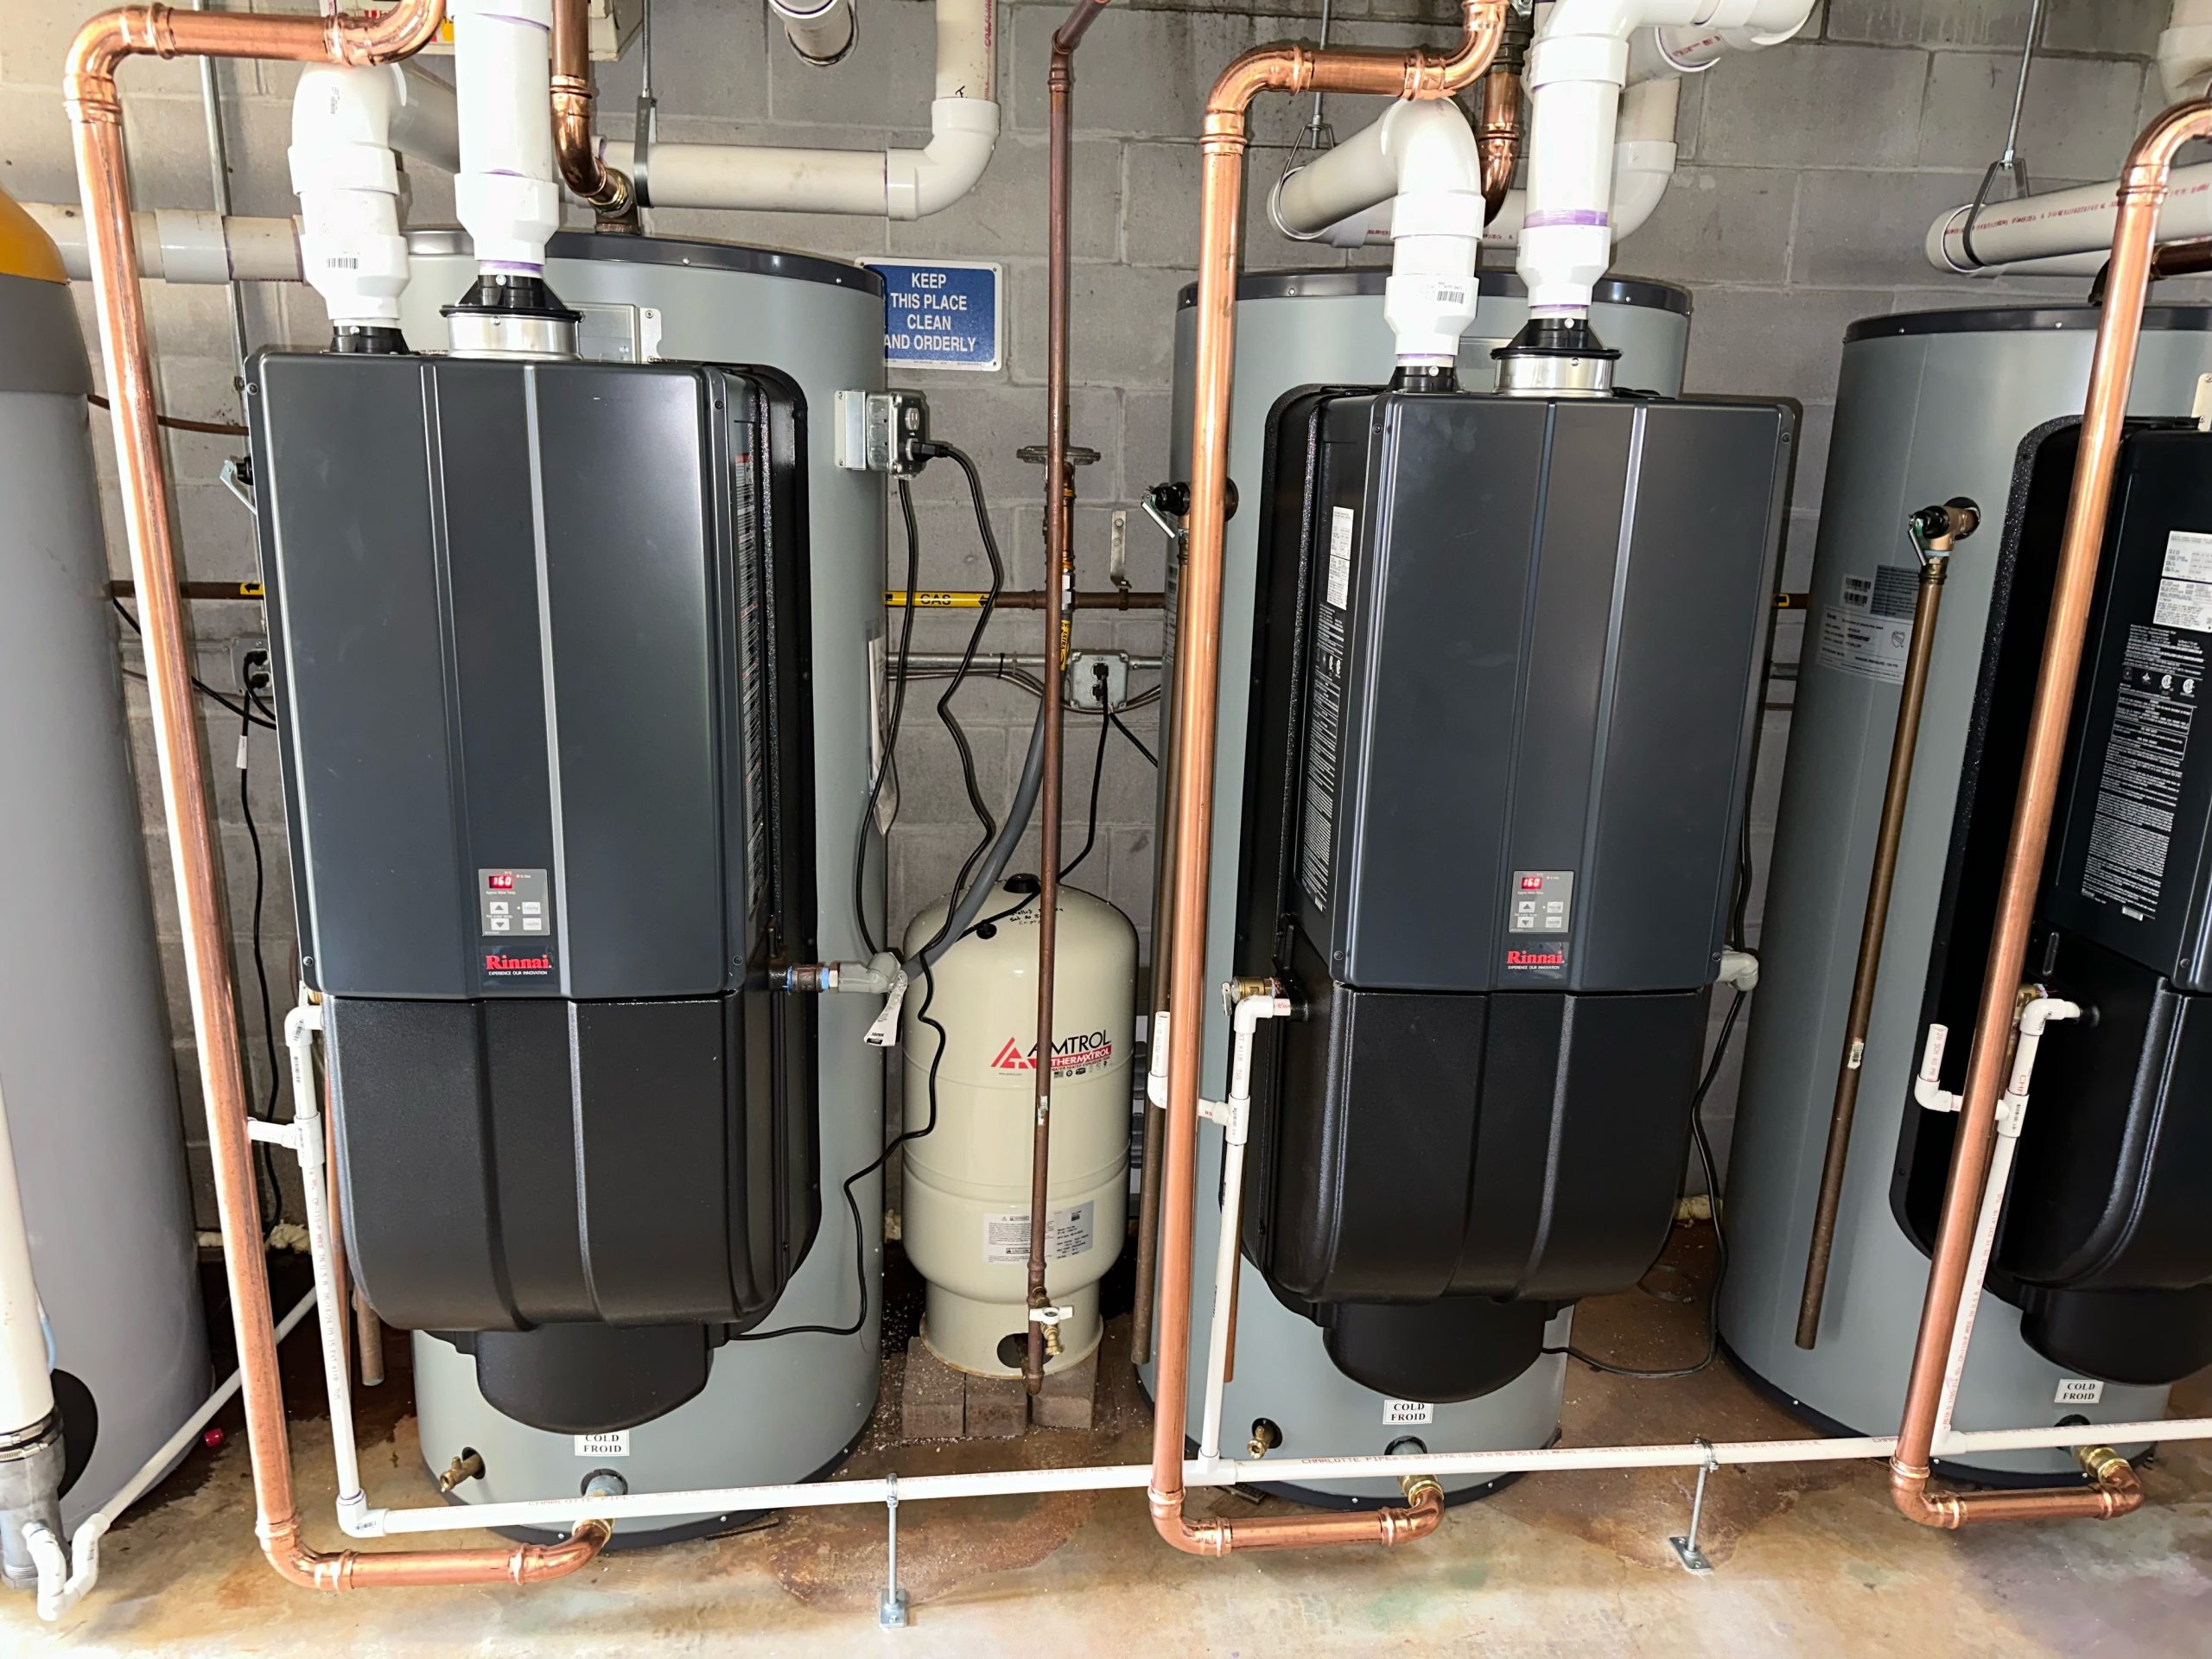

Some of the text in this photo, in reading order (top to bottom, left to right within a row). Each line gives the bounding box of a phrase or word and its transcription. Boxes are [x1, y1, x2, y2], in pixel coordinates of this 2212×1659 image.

[912, 272, 946, 289] KEEP
[891, 292, 967, 310] THIS PLACE
[907, 314, 950, 330] CLEAN
[884, 334, 976, 352] AND ORDERLY
[920, 594, 950, 605] GAS
[493, 876, 512, 887] 160
[1523, 878, 1541, 887] 160
[486, 954, 549, 969] Rinnai
[1507, 950, 1562, 964] Rinnai
[1394, 1402, 1425, 1411] COLD
[1391, 1413, 1426, 1421] FROID
